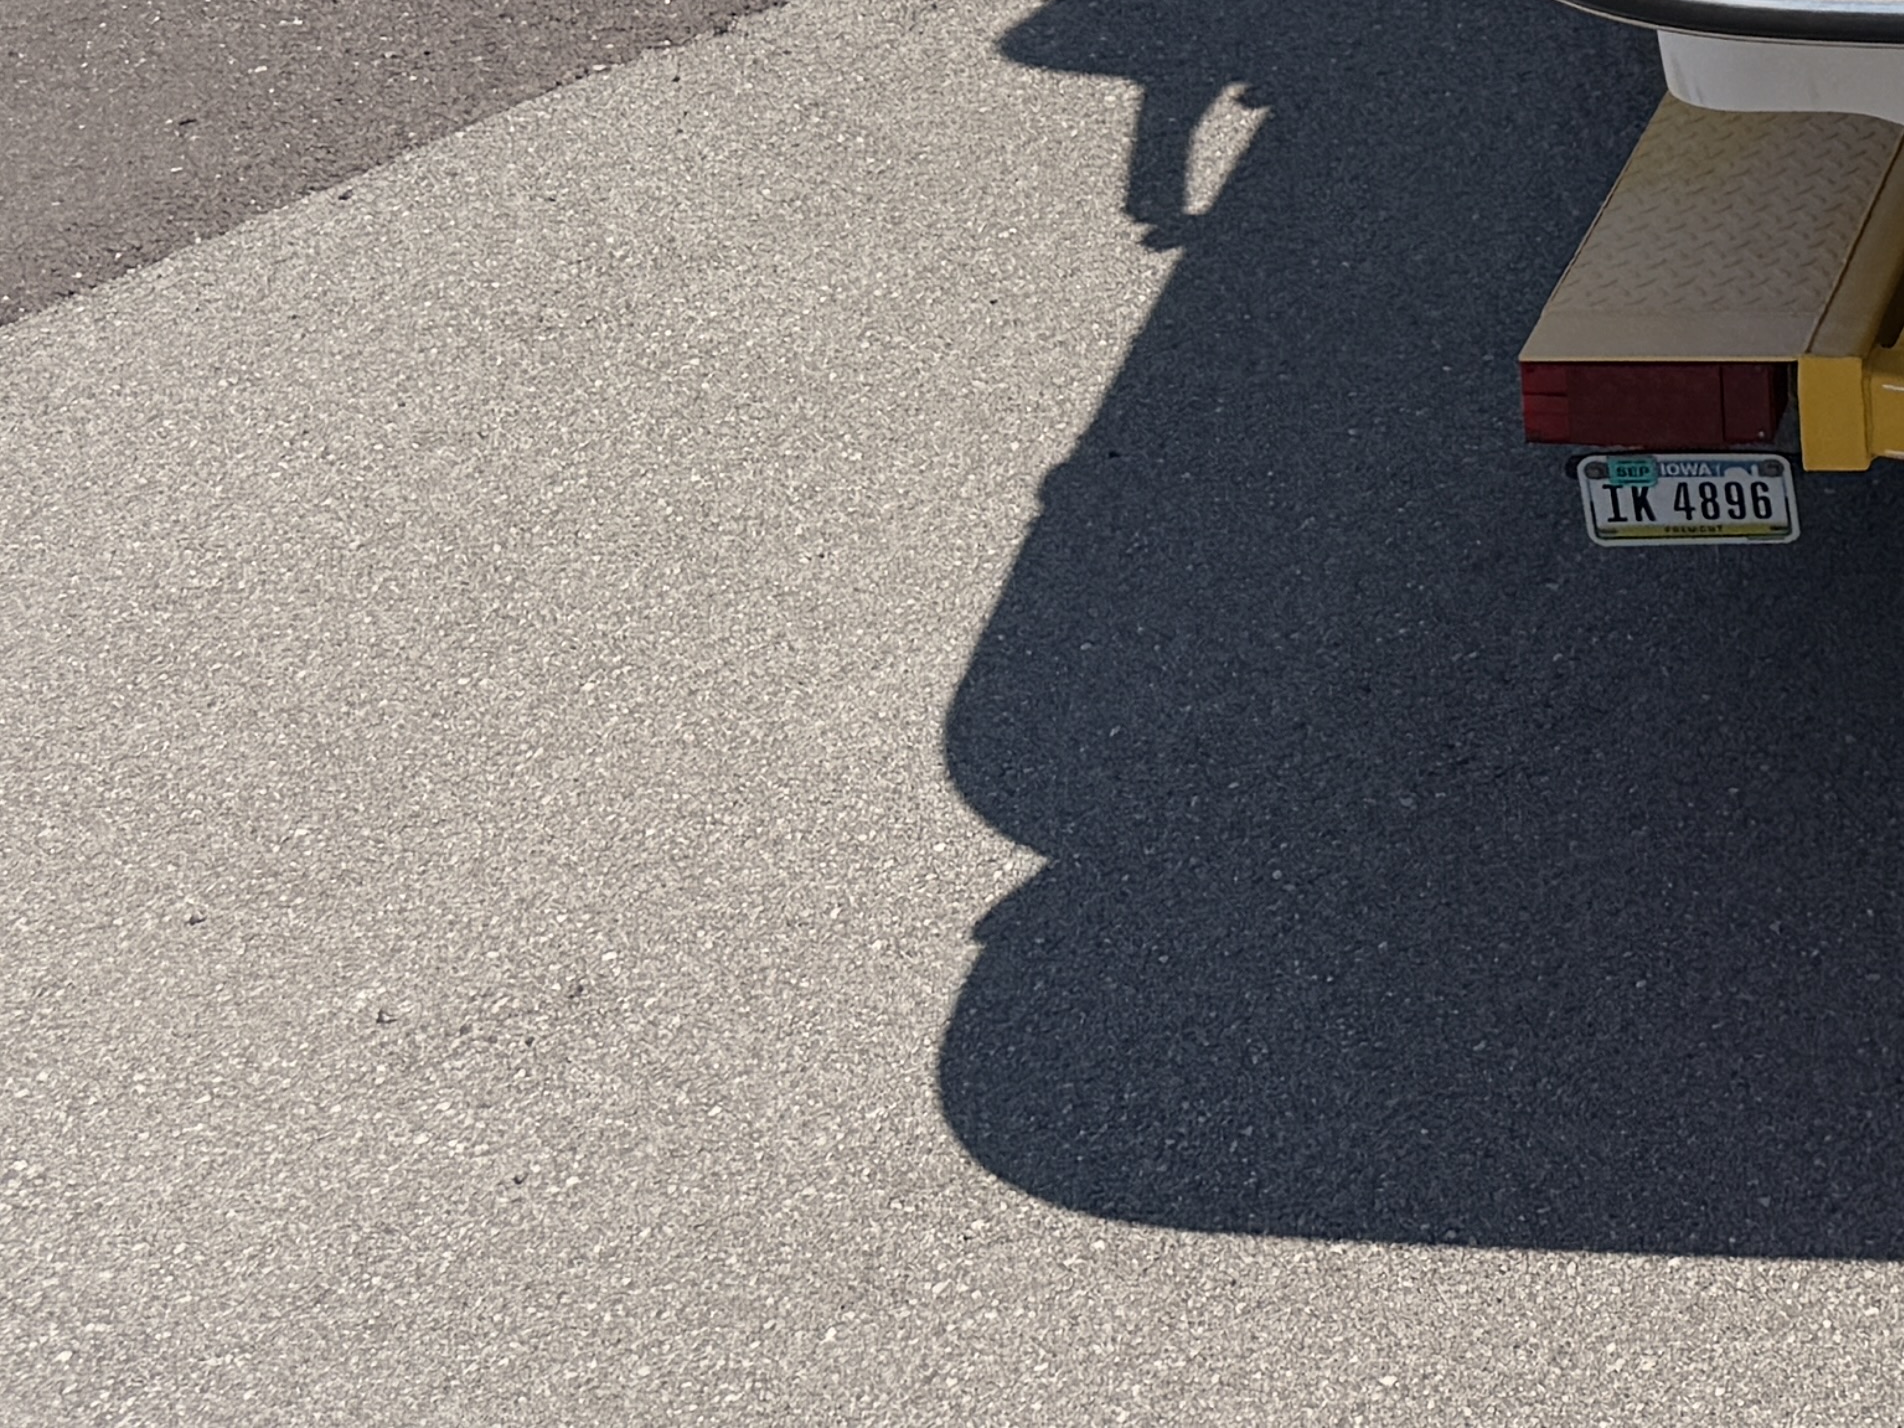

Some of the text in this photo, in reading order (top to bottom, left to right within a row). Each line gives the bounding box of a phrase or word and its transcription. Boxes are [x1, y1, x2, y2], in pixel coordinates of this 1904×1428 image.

[1615, 465, 1651, 478] SEP
[1660, 463, 1712, 476] IOWA
[1602, 481, 1773, 523] IK 4896
